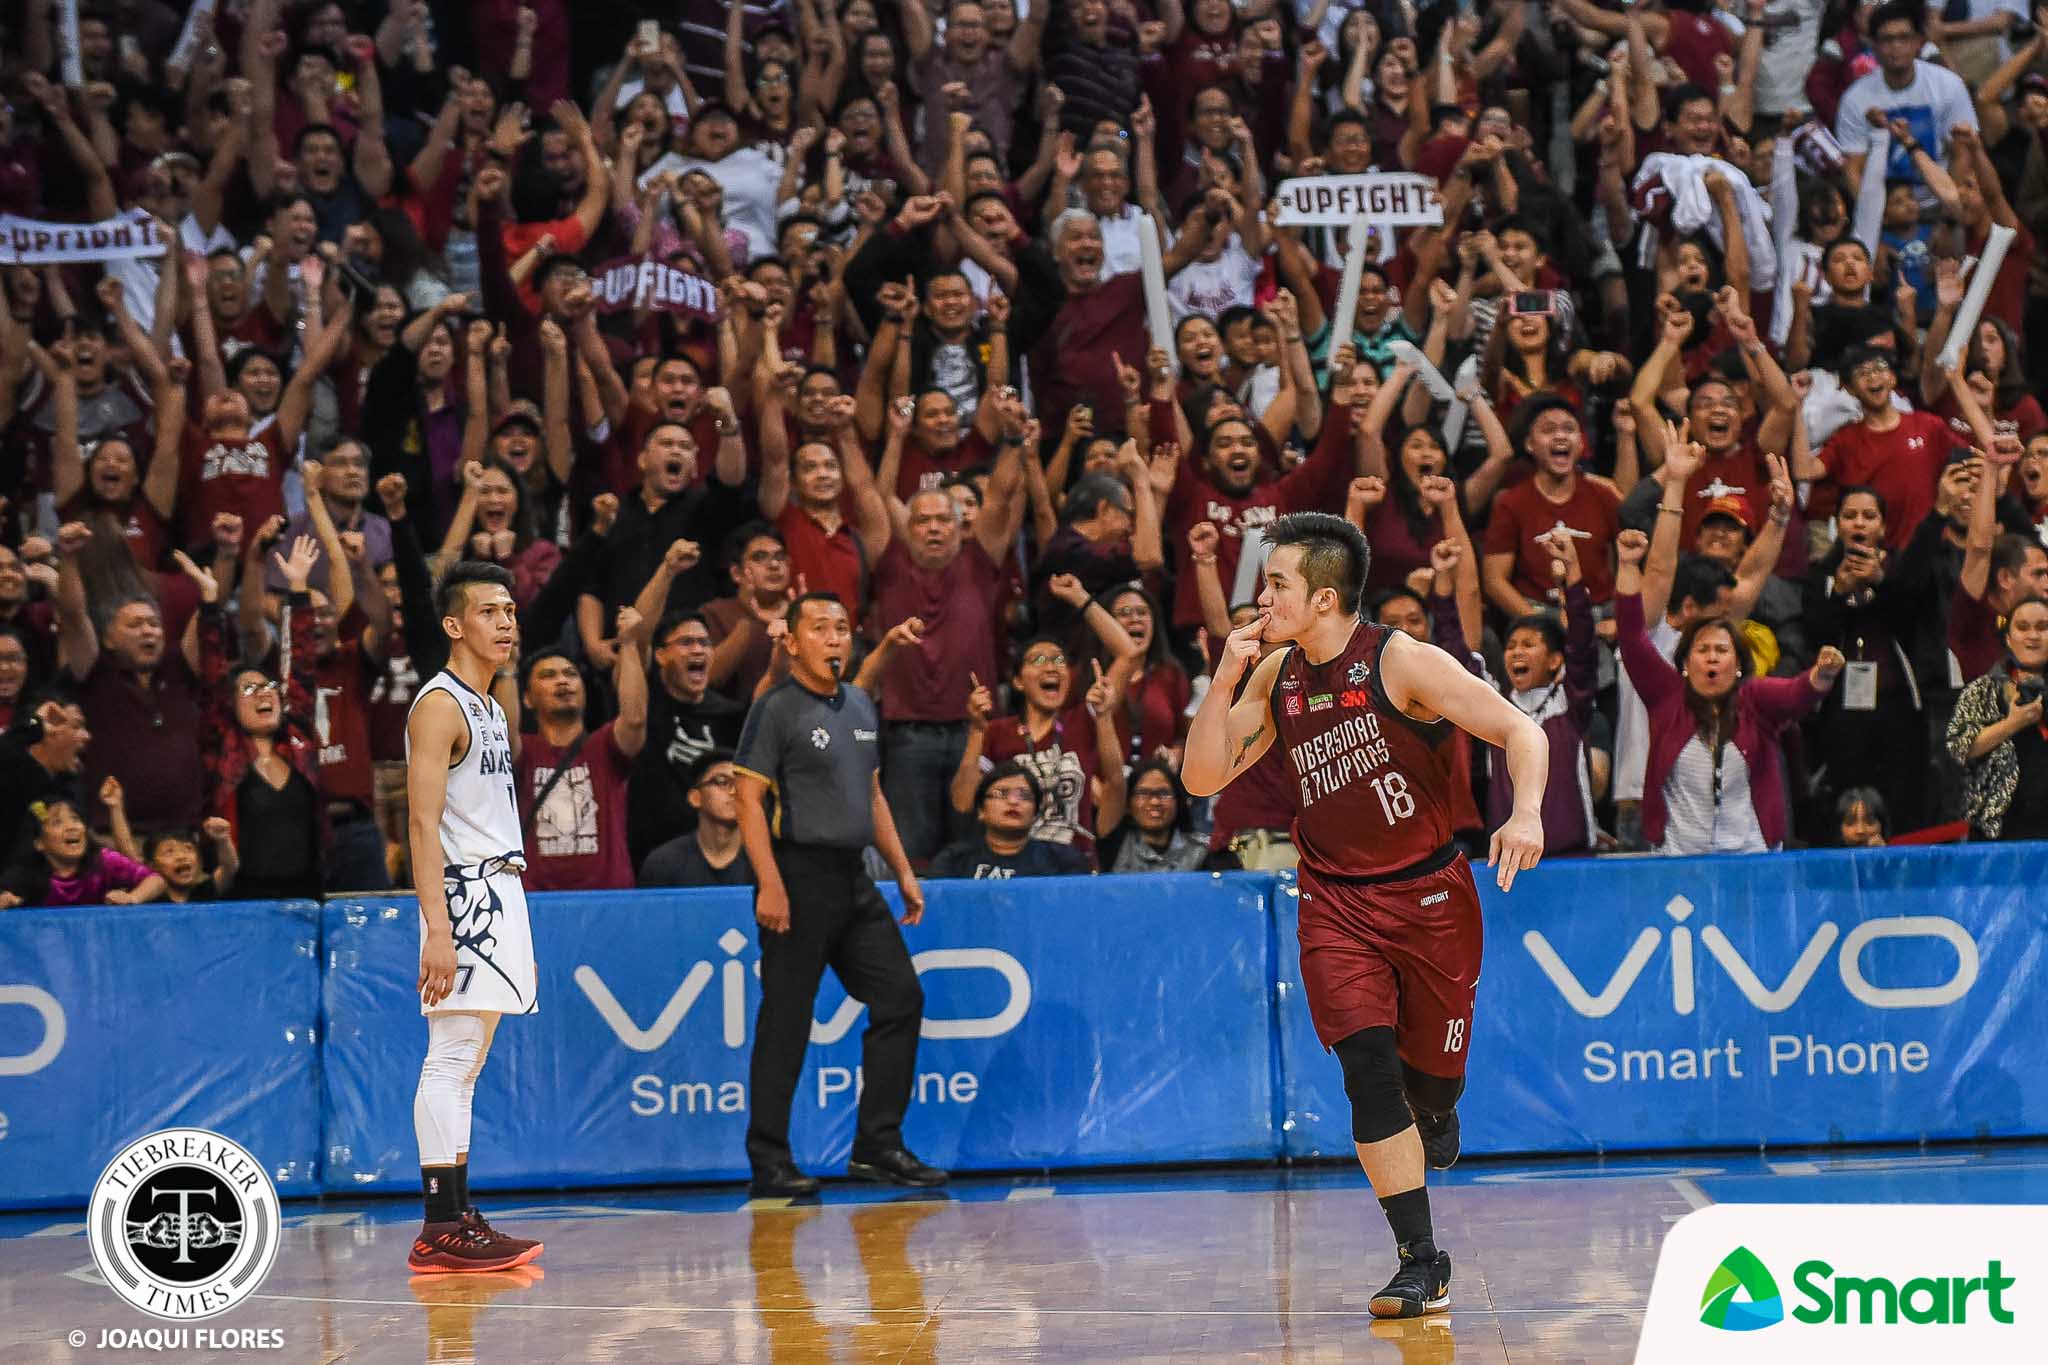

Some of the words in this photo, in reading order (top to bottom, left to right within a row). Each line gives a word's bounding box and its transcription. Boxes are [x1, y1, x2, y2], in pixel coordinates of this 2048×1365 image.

[1281, 184, 1426, 213] #UPFIGHT
[1341, 690, 1366, 707] 3M
[1369, 771, 1415, 826] 18
[1522, 894, 1980, 1019] vivo
[1443, 1018, 1465, 1053] 18
[1583, 1038, 1744, 1084] Smart
[1769, 1034, 1931, 1077] Phone
[631, 1074, 746, 1116] Sma
[817, 1067, 978, 1109] Pne
